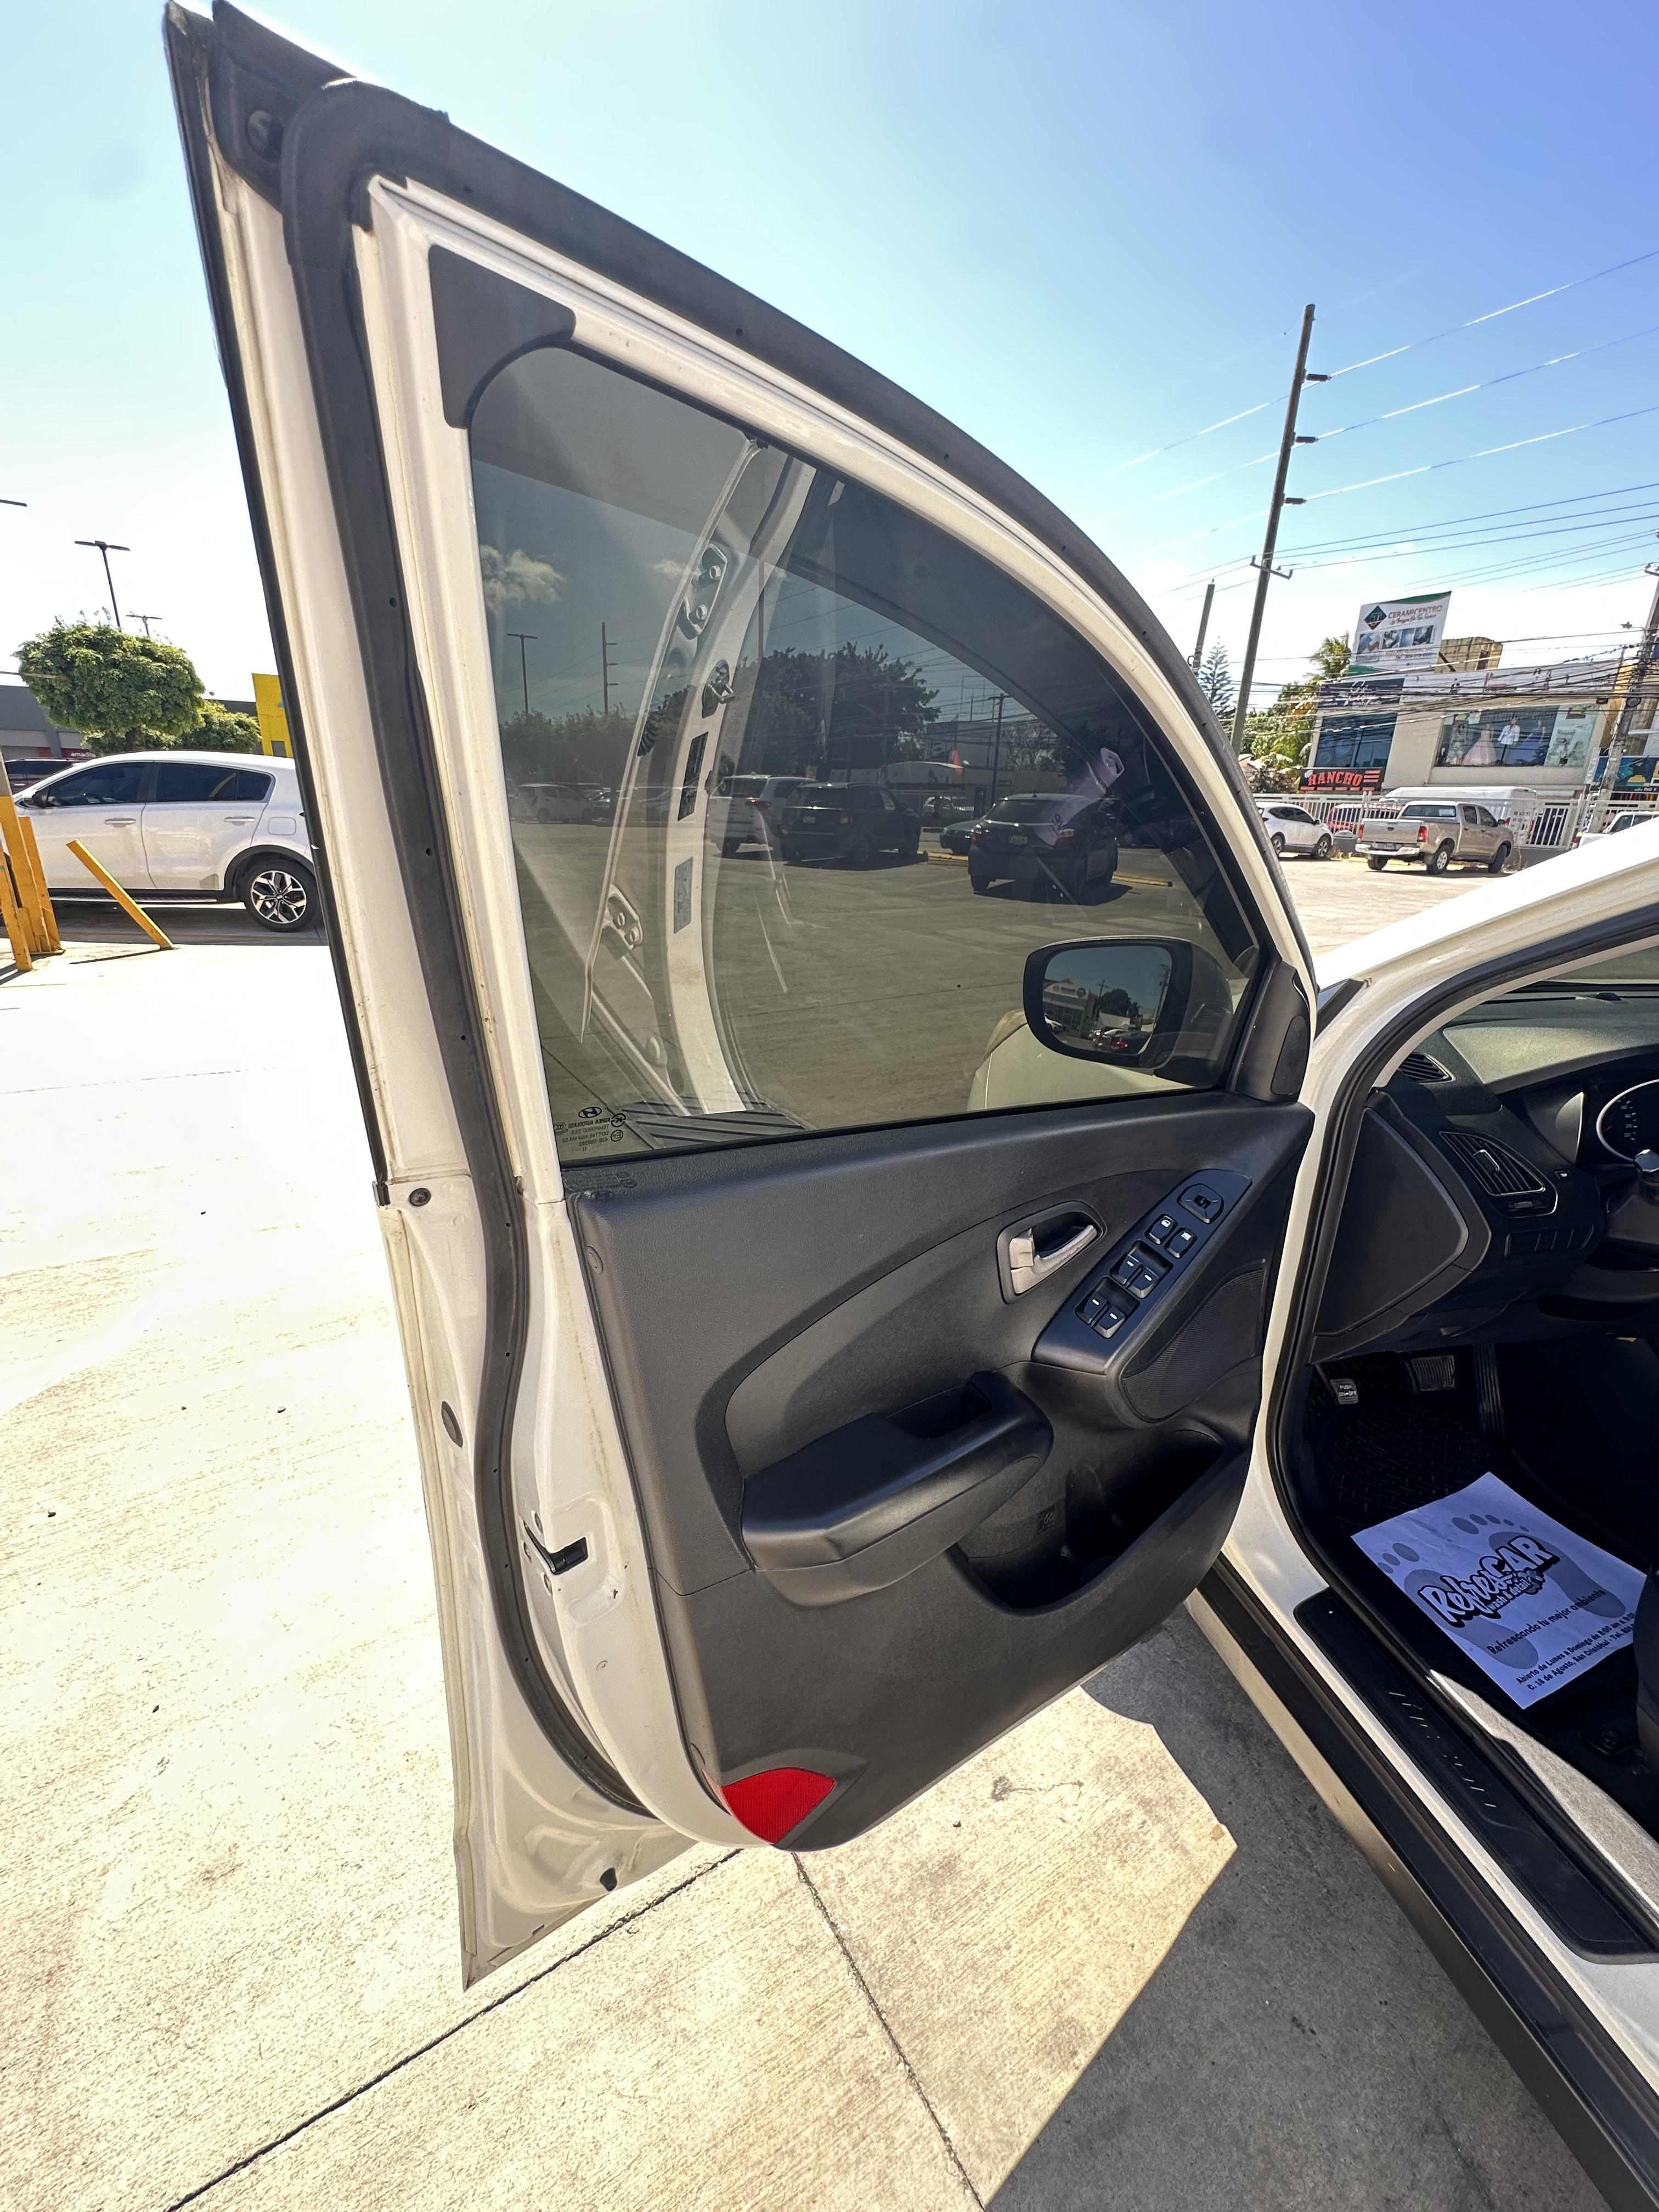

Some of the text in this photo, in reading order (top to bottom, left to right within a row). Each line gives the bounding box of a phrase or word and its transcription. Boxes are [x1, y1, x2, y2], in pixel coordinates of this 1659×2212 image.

[1388, 605, 1443, 619] CERAMICENTRO
[1308, 771, 1363, 786] RANCHO
[1486, 1594, 1508, 1611] wash
[1486, 1589, 1607, 1655] Refrescando tu mejor ambiente
[1516, 1668, 1539, 1684] Abierto
[1538, 1662, 1548, 1672] de
[1545, 1652, 1565, 1666] Lunes
[1567, 1637, 1593, 1654] Domingo
[1536, 1677, 1544, 1686] 16
[1543, 1672, 1553, 1681] de
[1553, 1660, 1576, 1676] Agosto,
[1572, 1653, 1587, 1663] San
